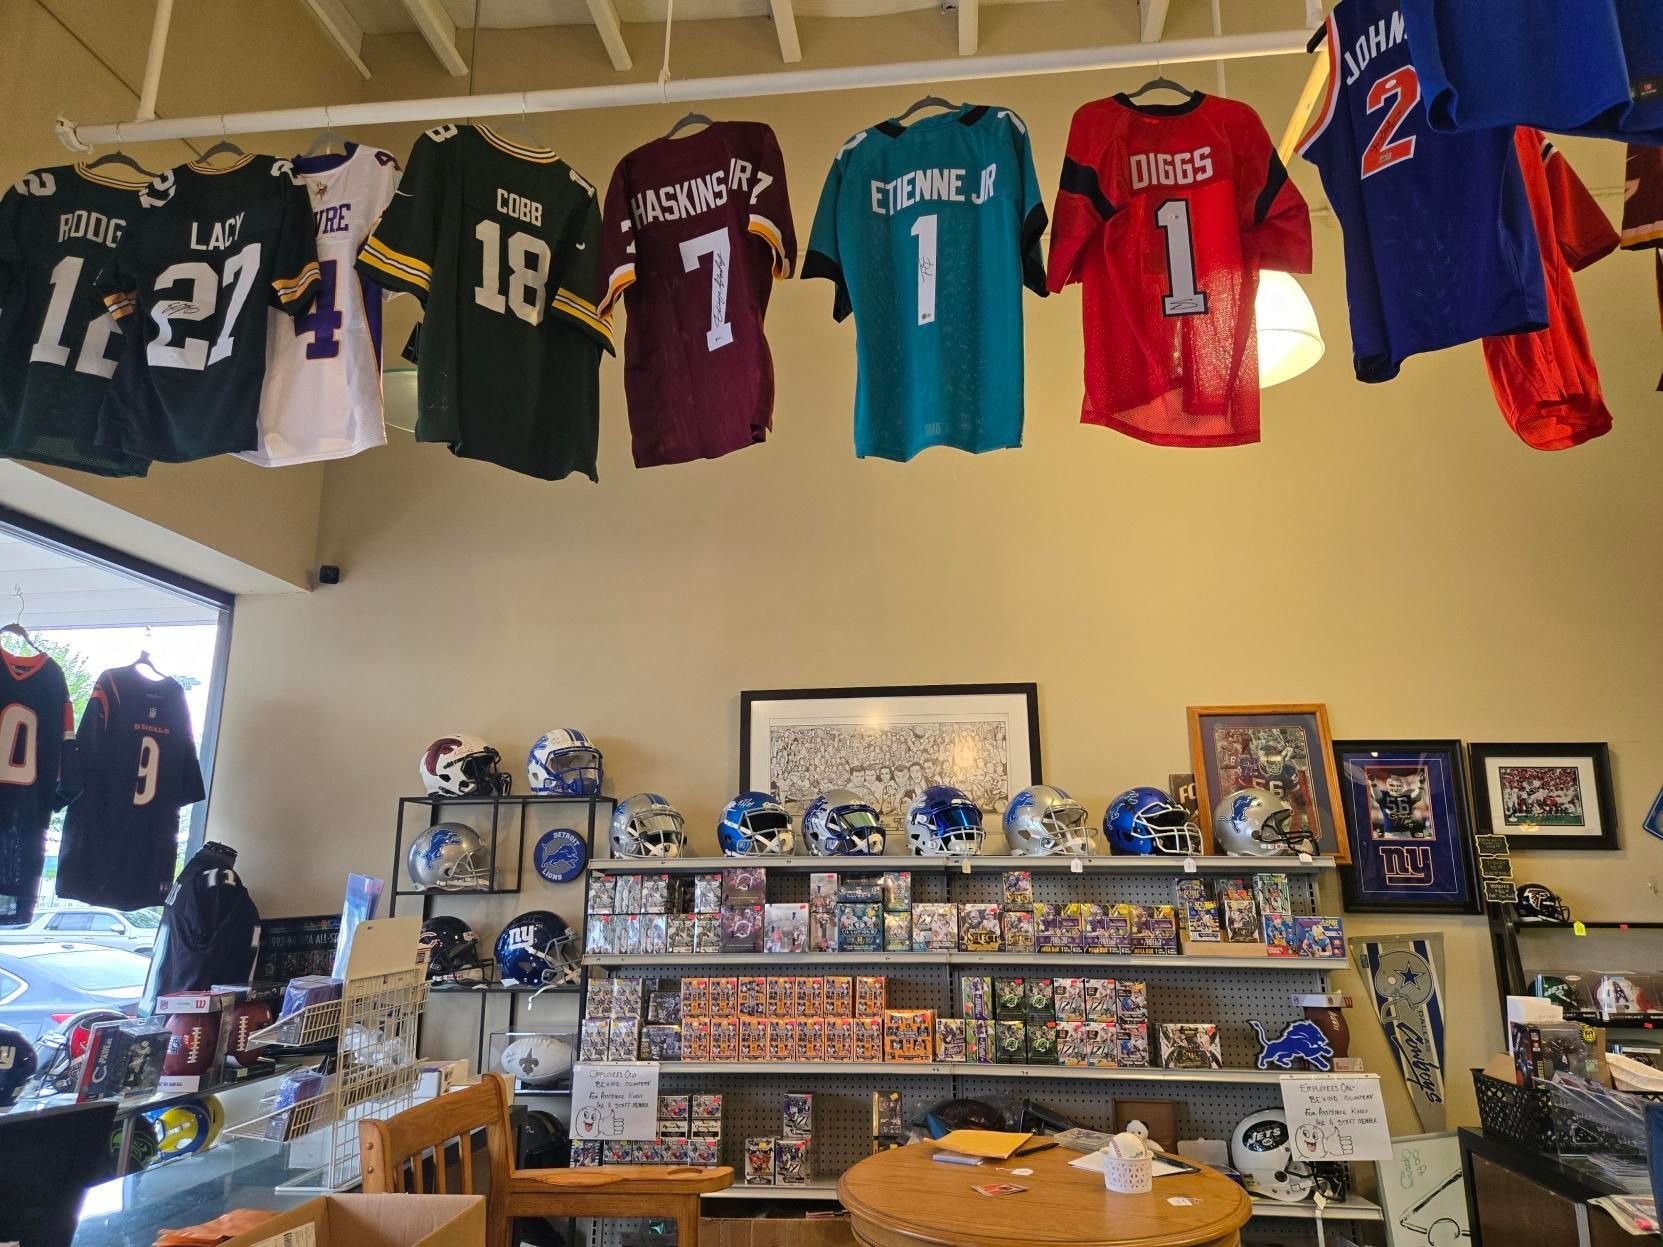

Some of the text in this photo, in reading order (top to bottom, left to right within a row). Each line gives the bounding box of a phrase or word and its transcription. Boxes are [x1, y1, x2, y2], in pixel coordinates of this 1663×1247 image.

[1344, 10, 1408, 85] JOHN
[1361, 64, 1421, 180] 2
[749, 171, 774, 205] 7
[870, 163, 997, 217] ETIENNE JR
[1129, 146, 1214, 190] DIGGS
[496, 188, 543, 227] COBB
[630, 169, 728, 230] HASKINS
[58, 209, 128, 249] RODG
[190, 211, 246, 251] LACY
[474, 218, 551, 327] 18
[910, 214, 938, 326] 1
[1155, 198, 1209, 318] 1
[146, 242, 263, 371] 27
[294, 259, 343, 360] 4
[679, 226, 734, 353] 7
[132, 735, 161, 807] 9
[553, 831, 580, 847] DETROIT
[541, 867, 563, 881] LIONS
[966, 931, 1000, 945] SELECT
[1418, 1010, 1431, 1053] DALLAS
[1391, 1022, 1442, 1103] Cowboys
[1249, 1127, 1281, 1144] JETS
